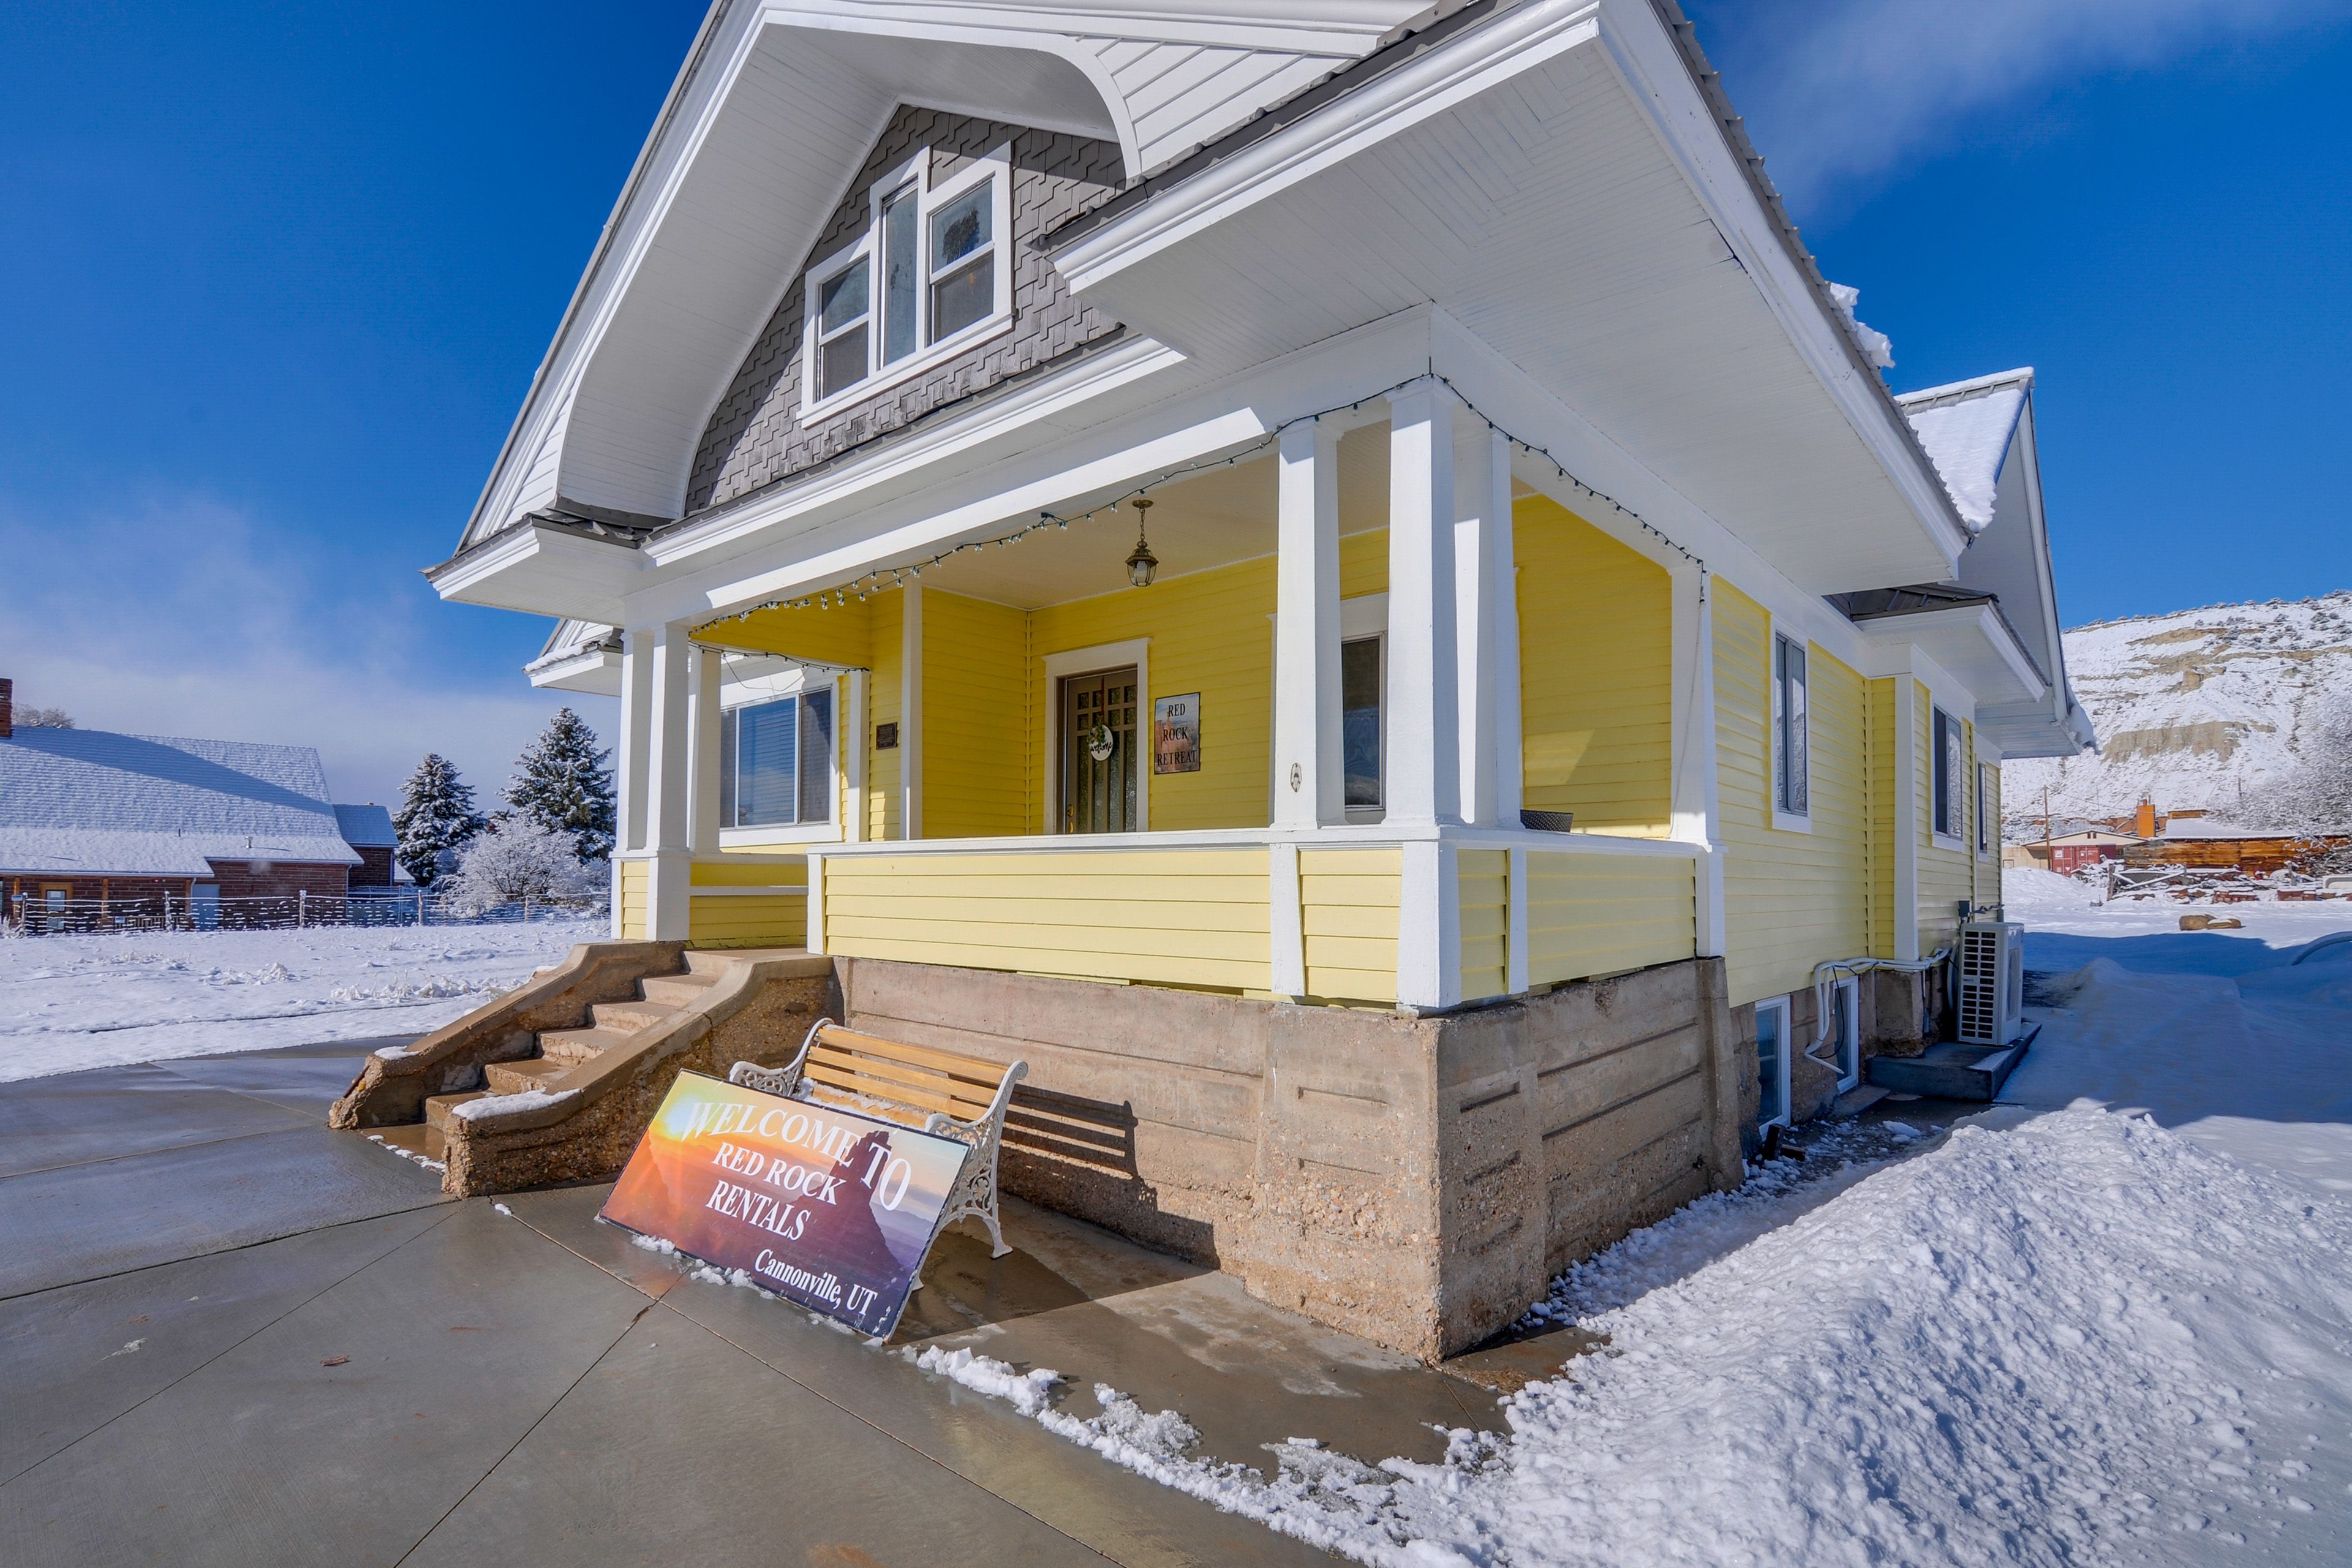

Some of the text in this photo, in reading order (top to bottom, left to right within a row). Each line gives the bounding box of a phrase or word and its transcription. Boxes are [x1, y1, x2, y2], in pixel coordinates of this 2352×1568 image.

[1163, 726, 1188, 742] ROCK
[1168, 703, 1186, 717] RED
[1157, 750, 1197, 766] RETREAT
[681, 1102, 911, 1211] WELCOME TO
[711, 1142, 847, 1205] RED ROCK
[706, 1180, 812, 1240] RENTALS
[755, 1249, 878, 1316] Cannonville, UT
